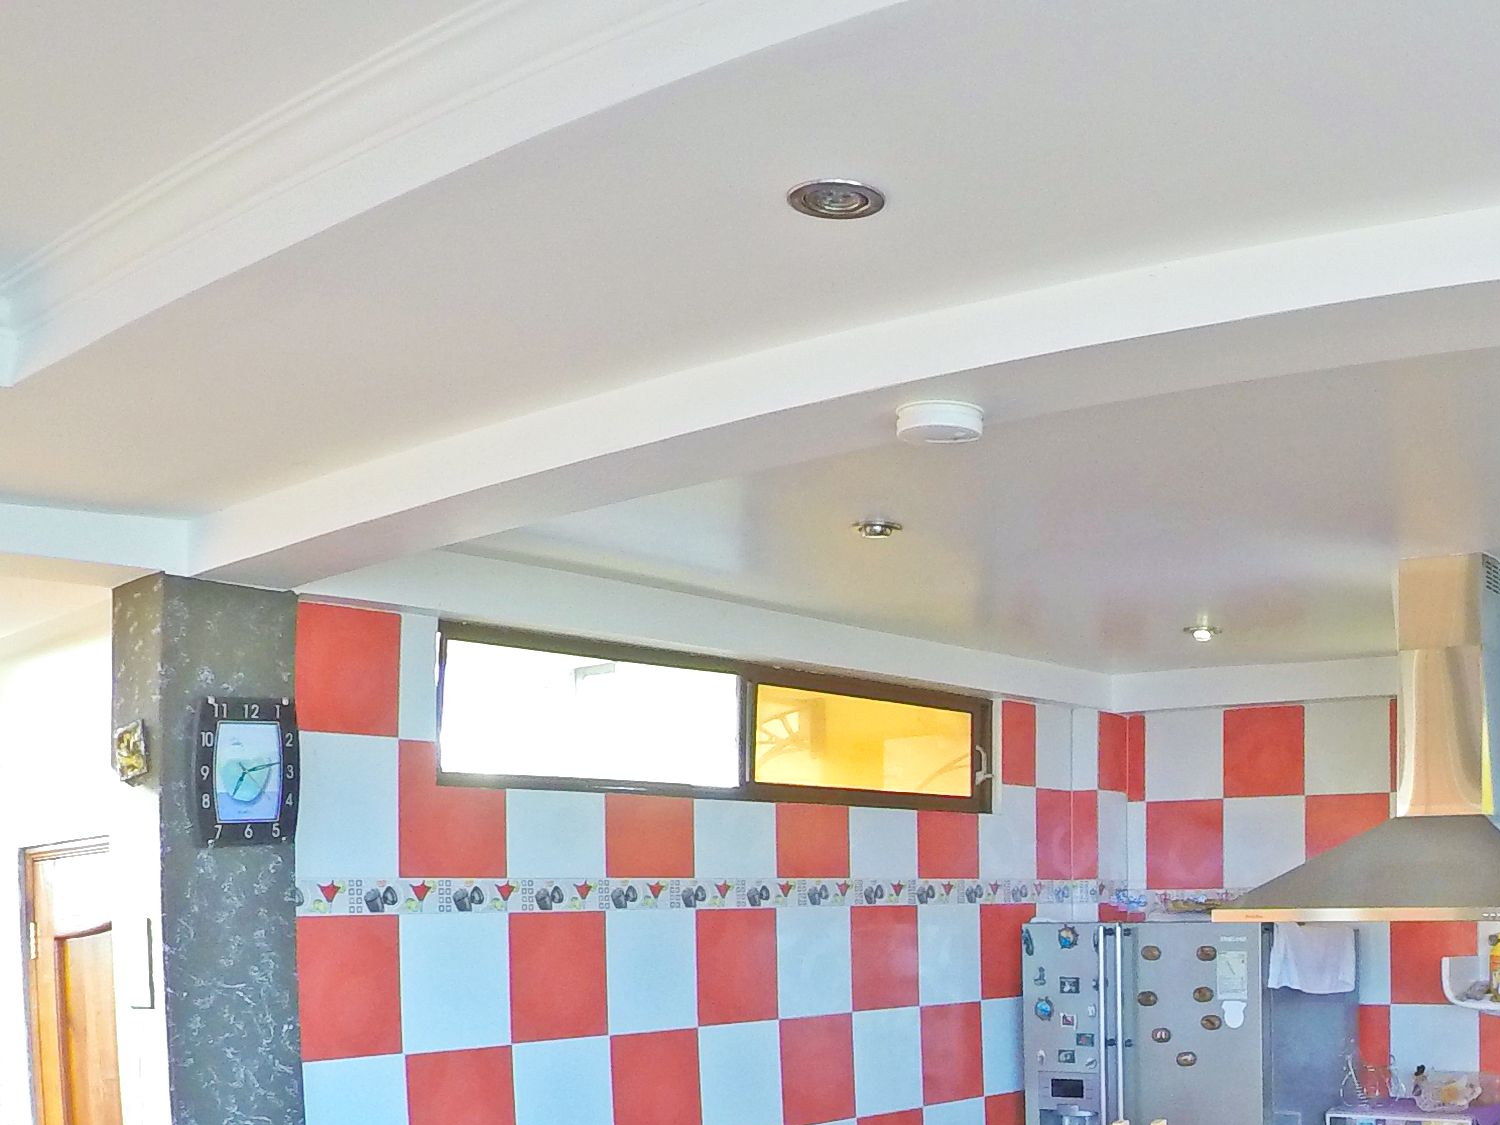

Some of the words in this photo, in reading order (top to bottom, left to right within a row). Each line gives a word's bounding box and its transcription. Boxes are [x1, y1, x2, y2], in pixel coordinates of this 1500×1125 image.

[213, 703, 228, 719] 11
[243, 703, 260, 719] 12
[275, 704, 281, 719] 1
[201, 731, 214, 747] 10
[285, 732, 294, 747] 2
[200, 765, 210, 781] 9
[286, 764, 294, 779] 3
[201, 793, 211, 809] 8
[285, 791, 294, 806] 4
[213, 824, 223, 840] 7
[244, 823, 254, 838] 6
[271, 822, 281, 838] 5
